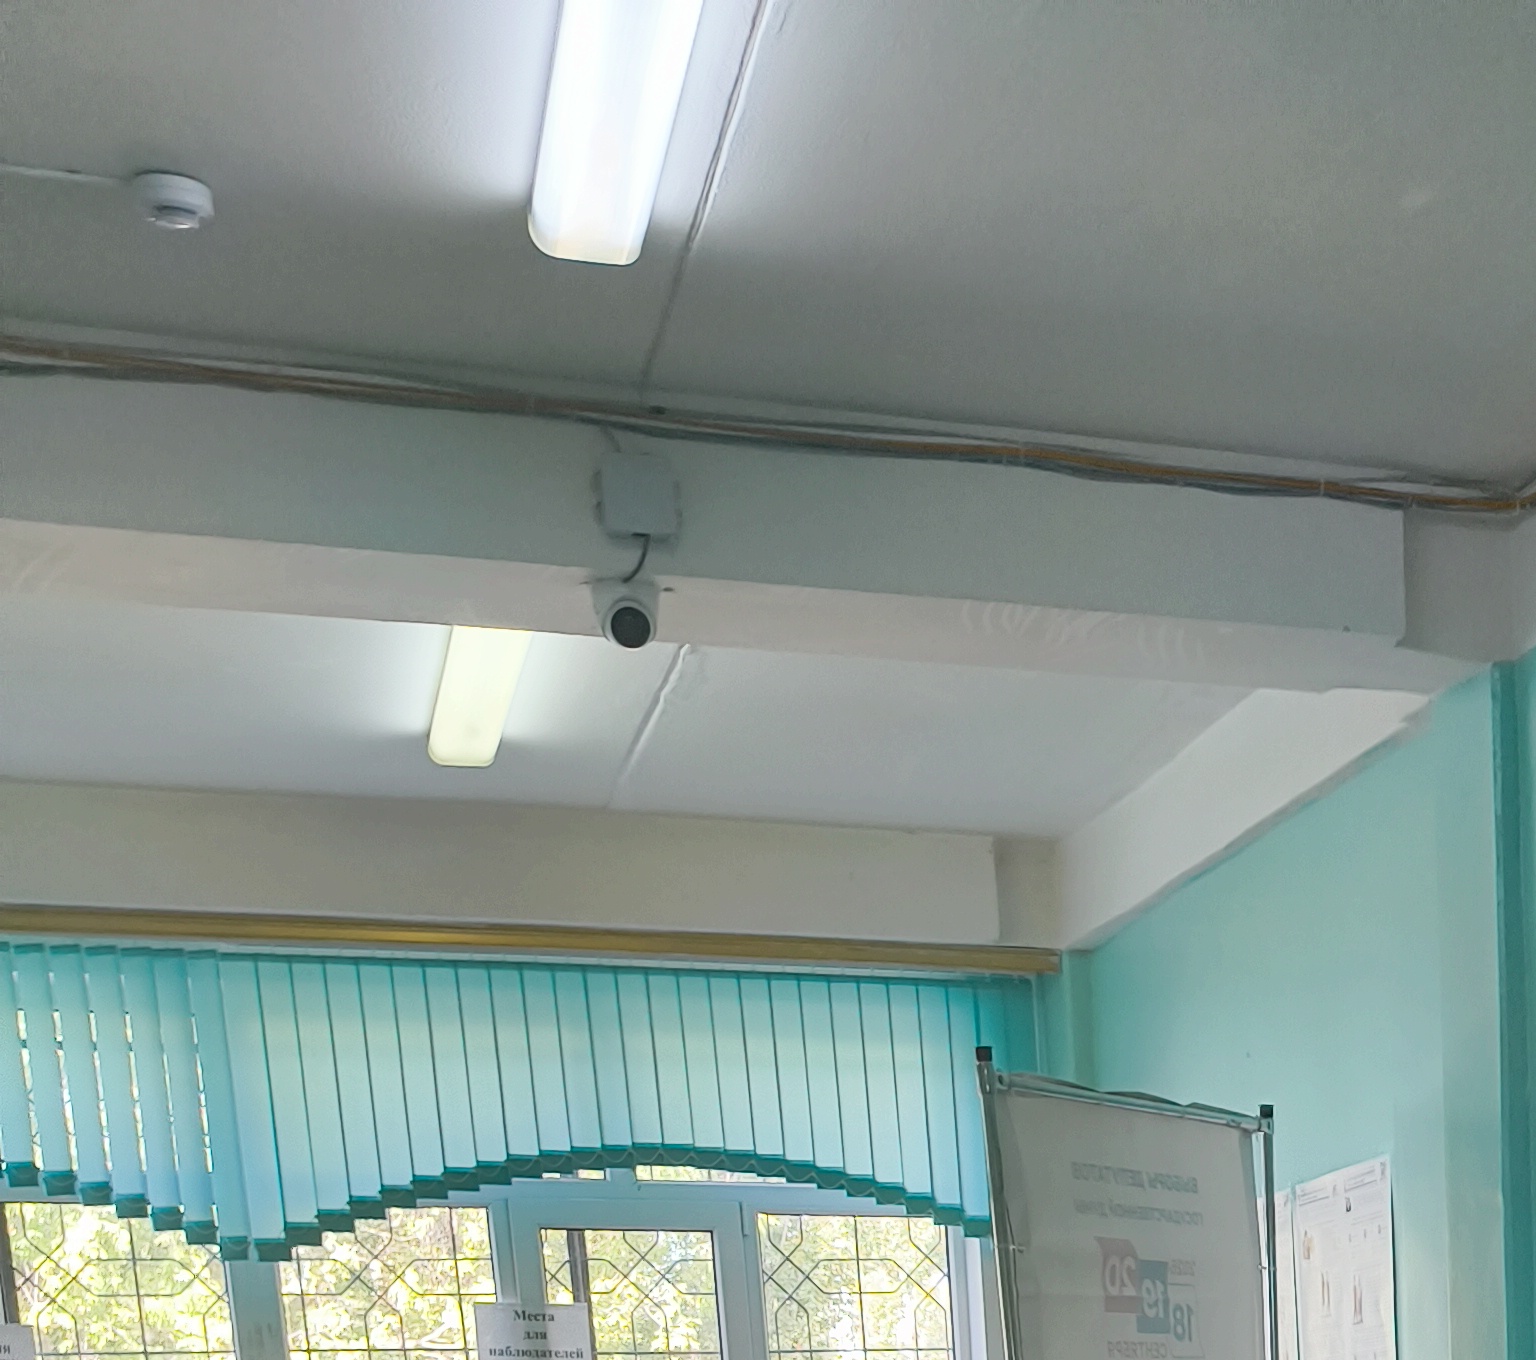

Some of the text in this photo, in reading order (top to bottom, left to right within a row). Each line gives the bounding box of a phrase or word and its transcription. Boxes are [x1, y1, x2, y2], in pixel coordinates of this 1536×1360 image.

[513, 1309, 555, 1322] Места
[523, 1330, 548, 1340] для
[489, 1346, 584, 1359] наблюдателей
